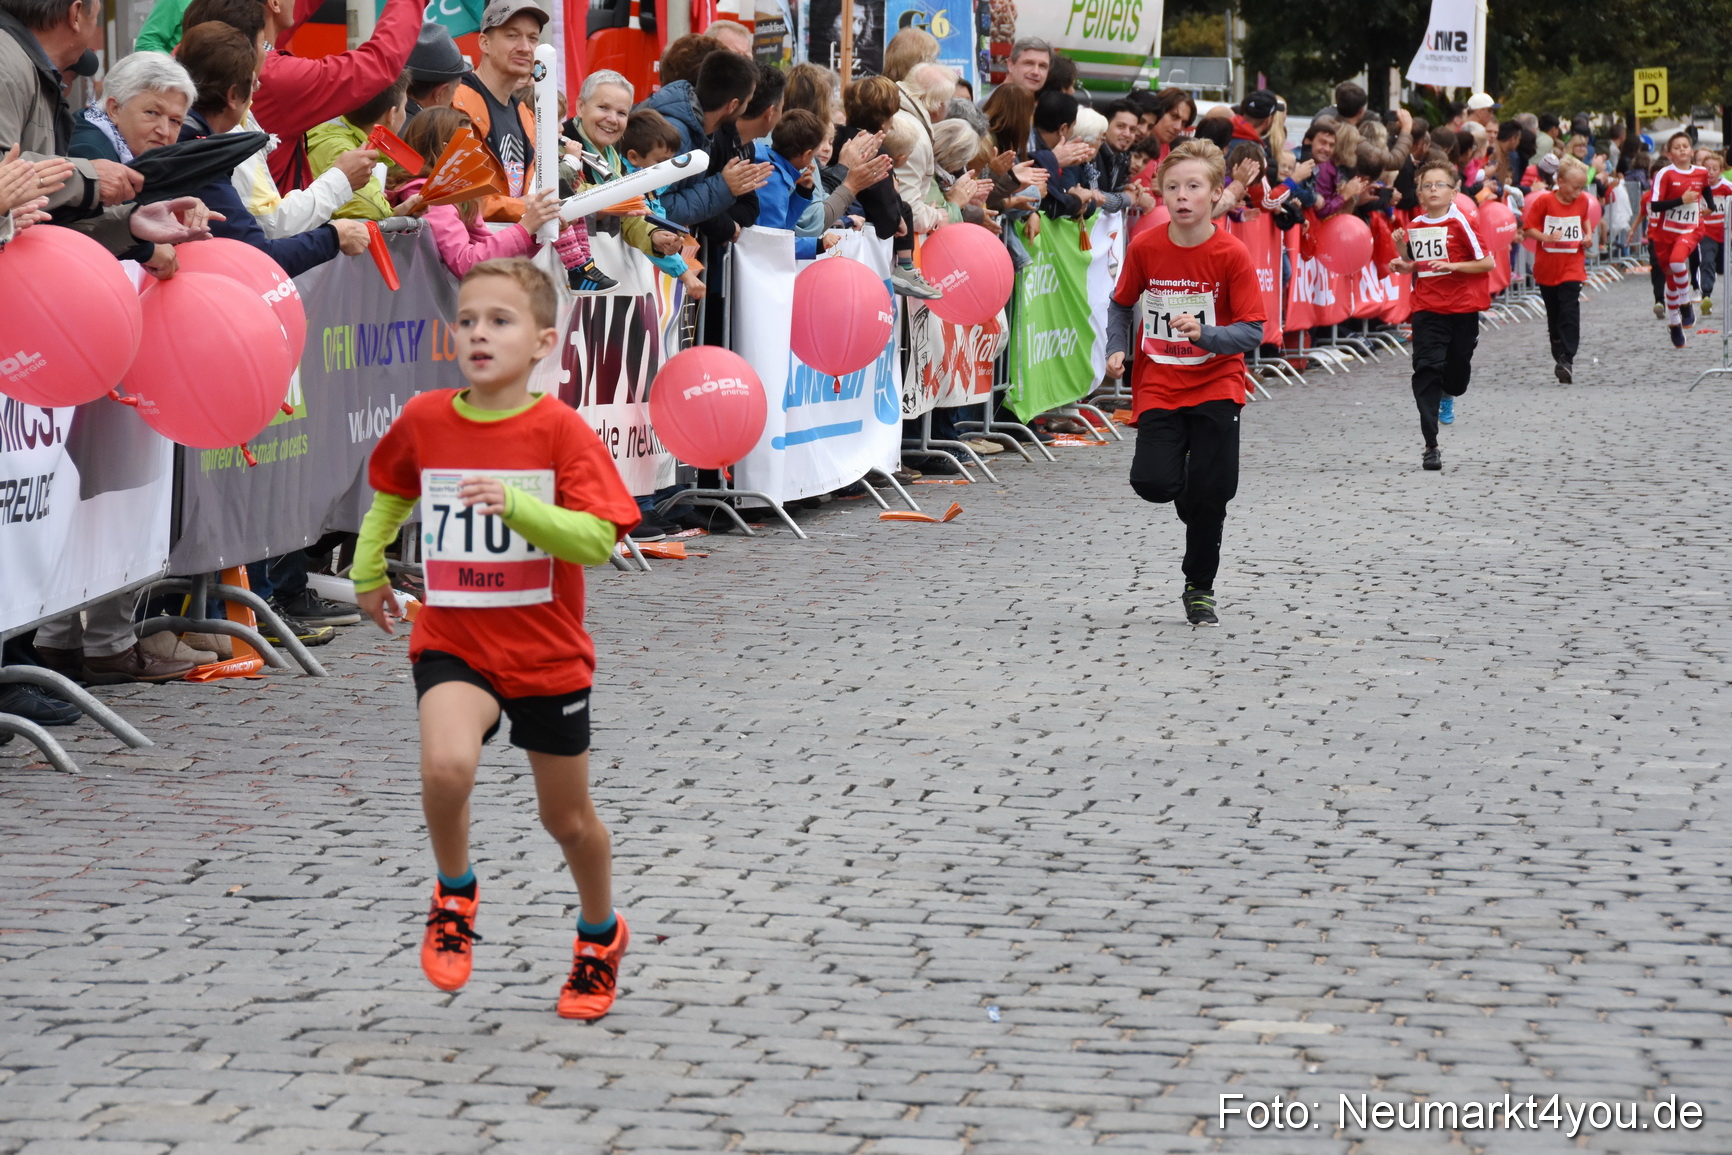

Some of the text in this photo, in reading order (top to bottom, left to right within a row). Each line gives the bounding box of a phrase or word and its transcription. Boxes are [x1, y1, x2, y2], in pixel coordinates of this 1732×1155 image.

[1065, 0, 1143, 43] Pellets
[1638, 70, 1663, 80] Block
[1643, 83, 1660, 106] D
[1669, 208, 1696, 222] 7141
[1411, 238, 1443, 259] 215
[1149, 278, 1200, 288] Neumarkter
[1148, 310, 1206, 338] 711
[1164, 344, 1194, 356] Julian
[9, 359, 47, 382] energie
[682, 372, 749, 400] RÖDL
[721, 388, 750, 396] energie
[432, 503, 536, 554] 710
[458, 567, 505, 588] Marc
